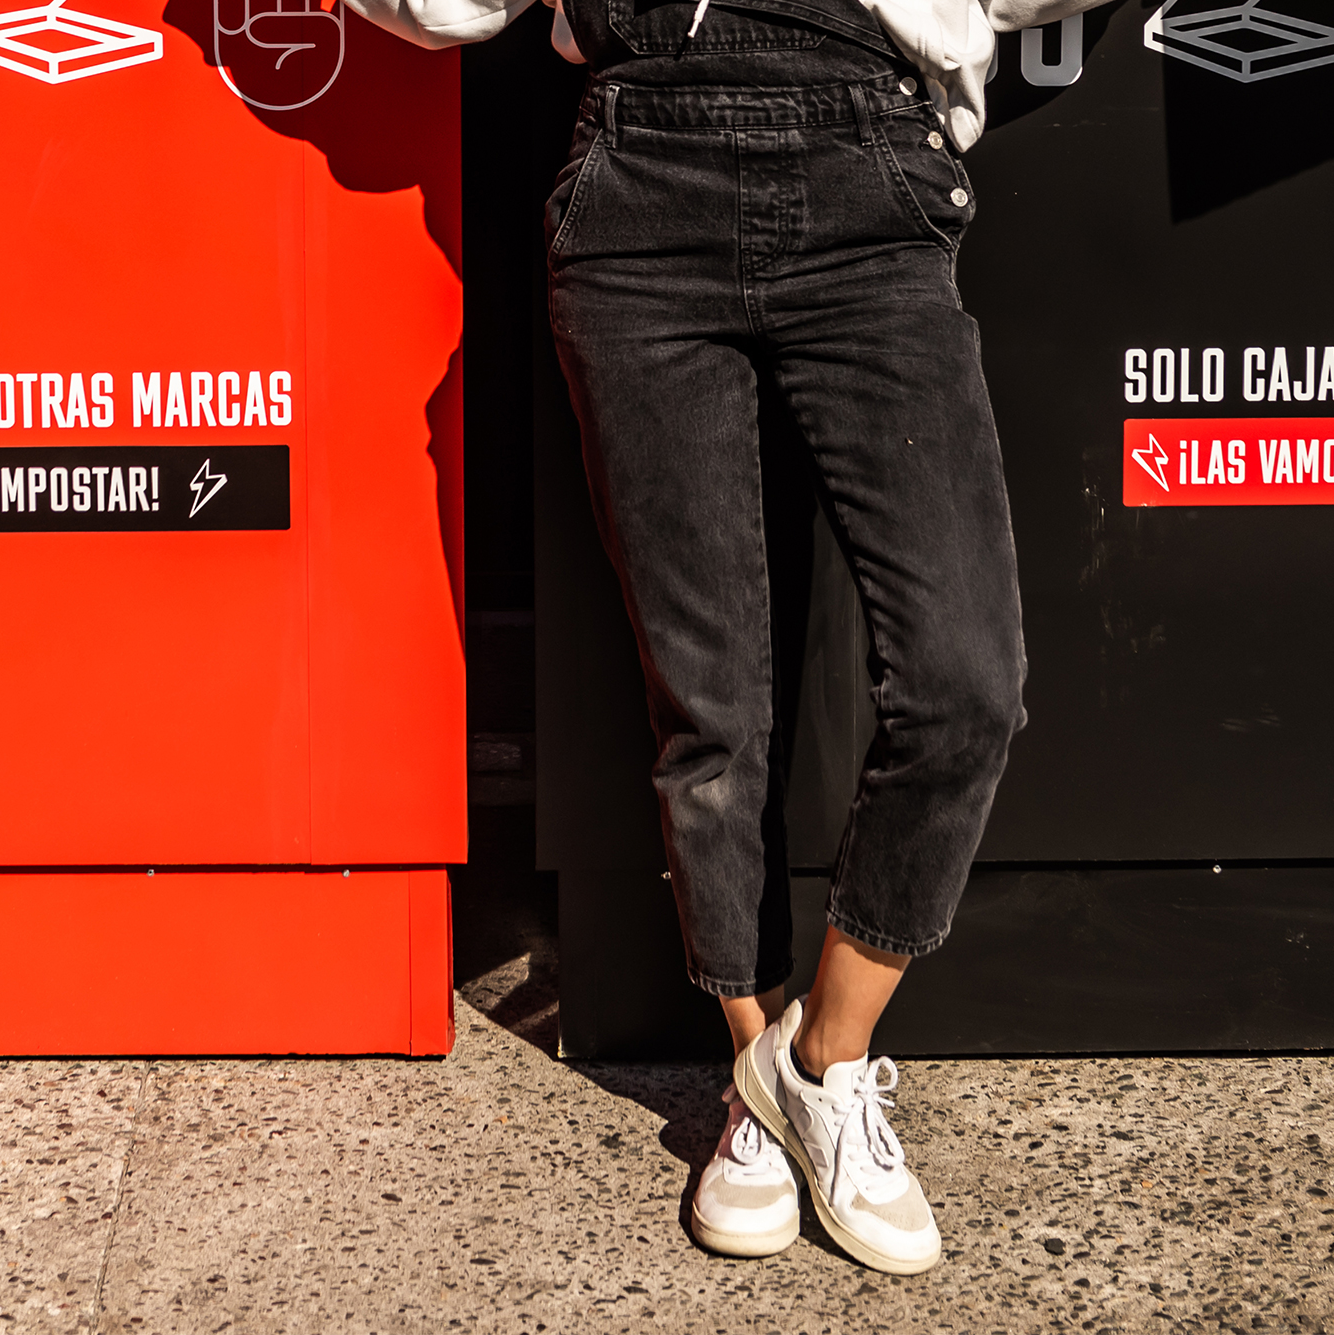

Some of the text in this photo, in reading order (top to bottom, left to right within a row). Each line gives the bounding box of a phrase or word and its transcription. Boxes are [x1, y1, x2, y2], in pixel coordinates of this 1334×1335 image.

[131, 369, 293, 428] MARCAS
[1124, 347, 1225, 403] SOLO
[1178, 439, 1246, 485] ¡LAS
